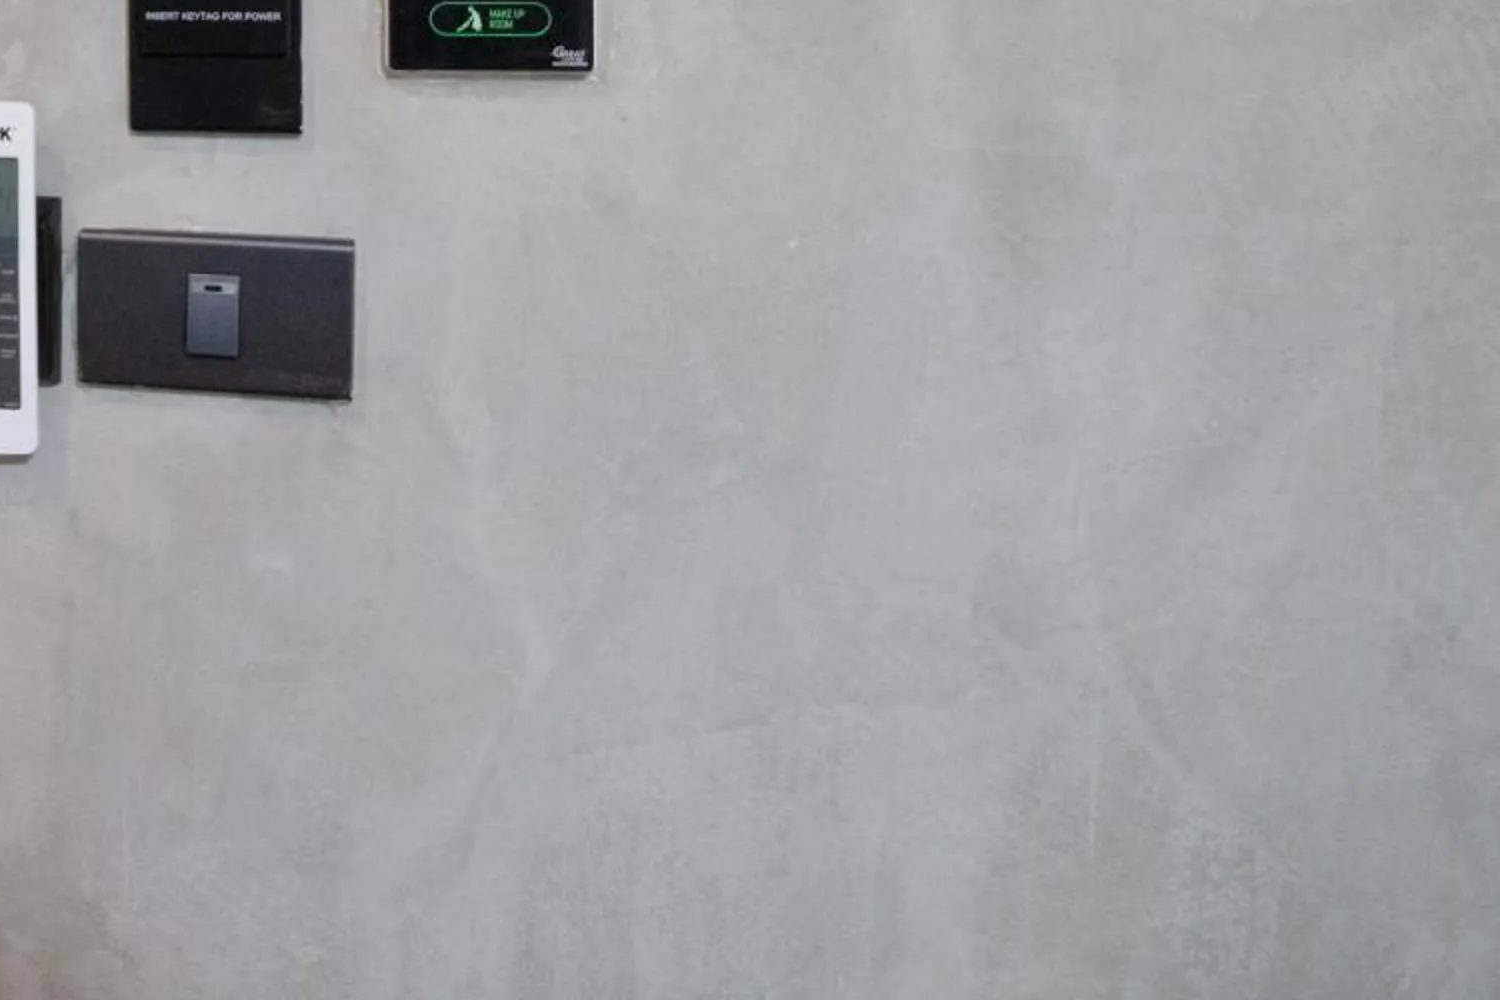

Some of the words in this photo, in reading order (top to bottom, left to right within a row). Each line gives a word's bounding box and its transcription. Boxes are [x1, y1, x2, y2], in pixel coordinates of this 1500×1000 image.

[145, 11, 180, 21] INSERT
[181, 11, 220, 21] KEYTAG
[221, 11, 242, 21] FOR
[244, 11, 281, 21] POWER
[489, 8, 512, 18] MAKE
[513, 8, 525, 19] UP
[489, 20, 513, 29] ROOM
